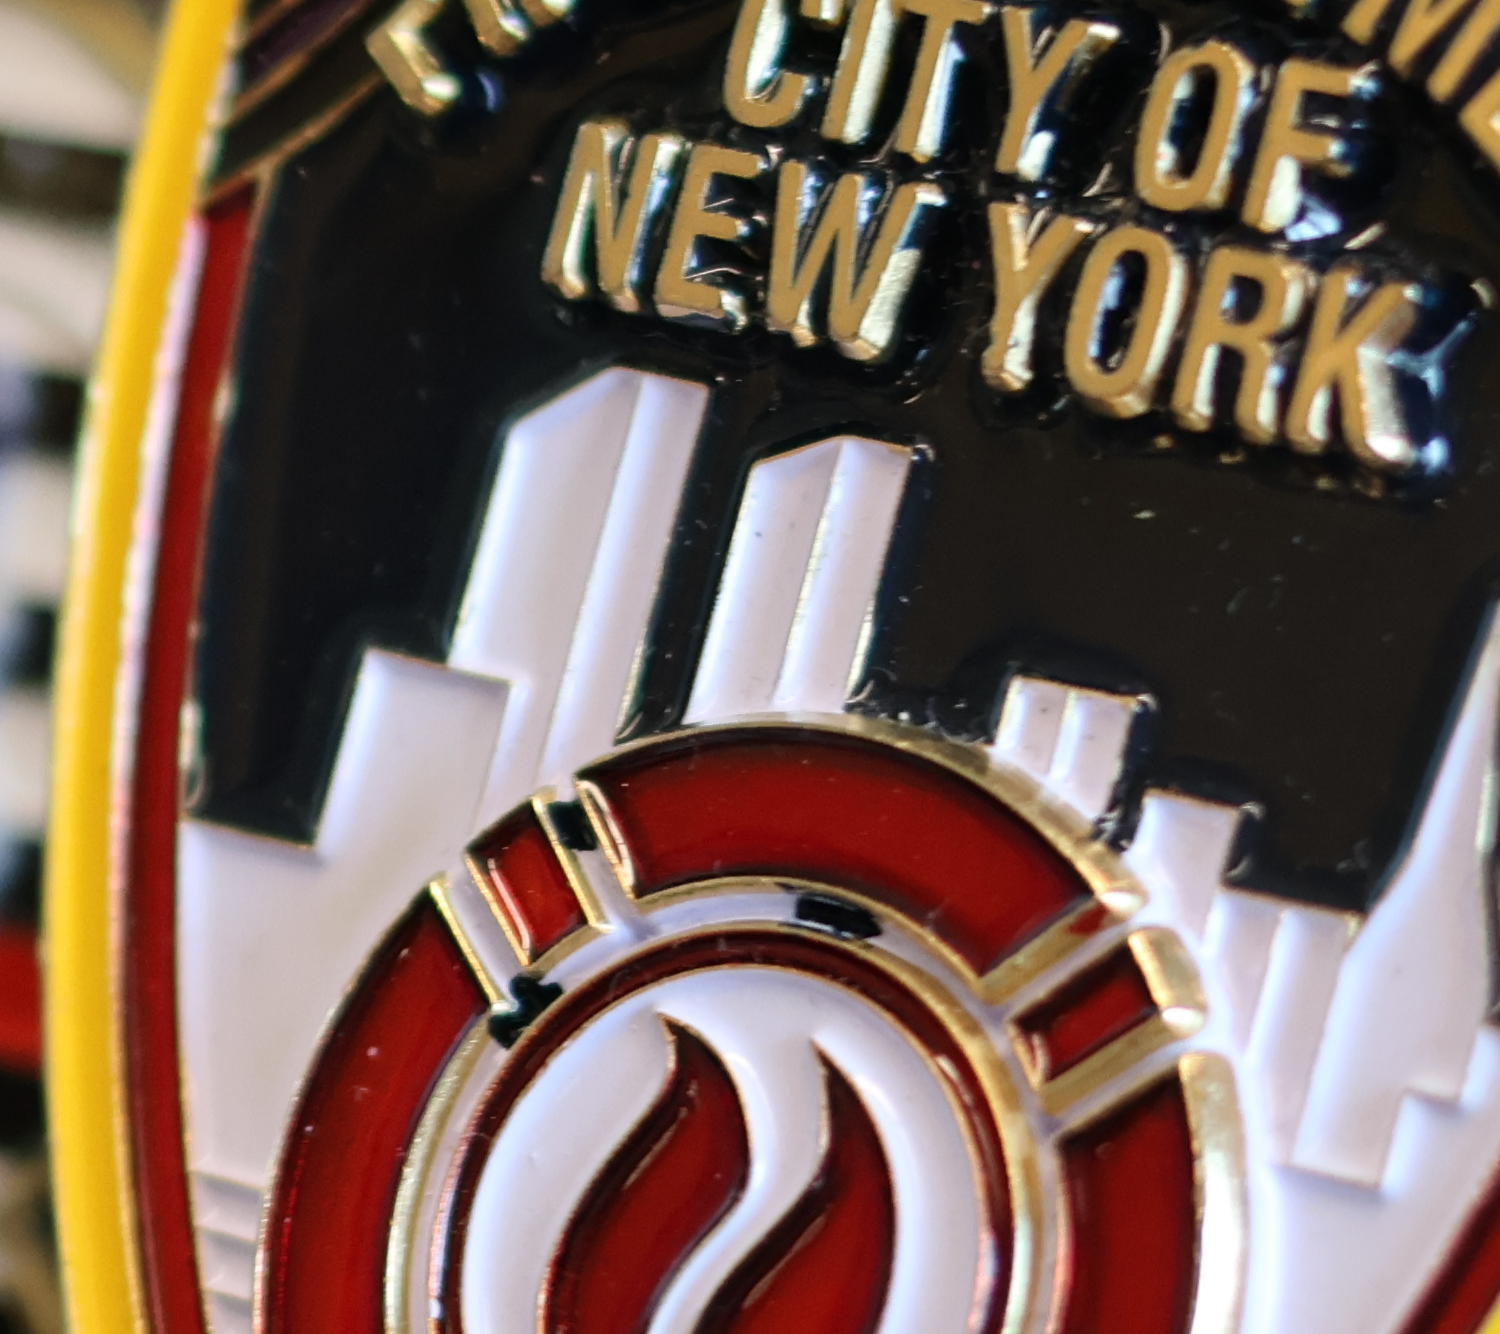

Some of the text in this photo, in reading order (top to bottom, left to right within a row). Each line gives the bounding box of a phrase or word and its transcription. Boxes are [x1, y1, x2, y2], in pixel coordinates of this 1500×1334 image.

[1135, 41, 1372, 234] OF
[542, 118, 1430, 467] NEW YORK
